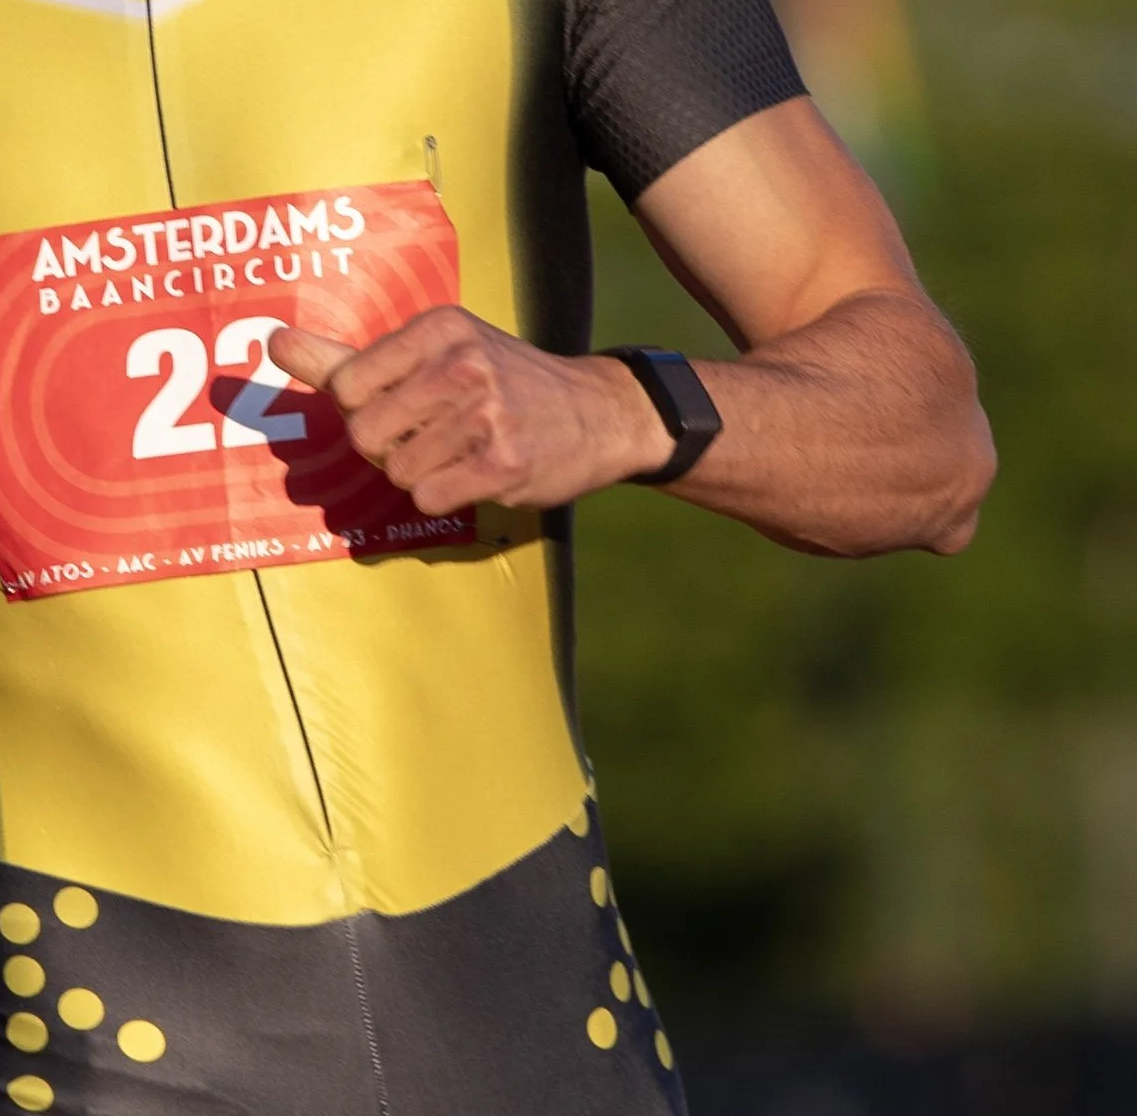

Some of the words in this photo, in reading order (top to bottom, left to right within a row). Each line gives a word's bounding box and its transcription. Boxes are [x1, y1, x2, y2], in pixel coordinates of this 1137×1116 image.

[31, 195, 366, 282] AMSTERDAMS
[38, 247, 355, 315] BAANCIRCUIT
[125, 315, 308, 460] 22
[40, 560, 95, 586] ATOS
[117, 553, 156, 574] AAC
[178, 547, 205, 567] AV
[210, 537, 286, 563] FENIKS
[307, 531, 334, 553] AV
